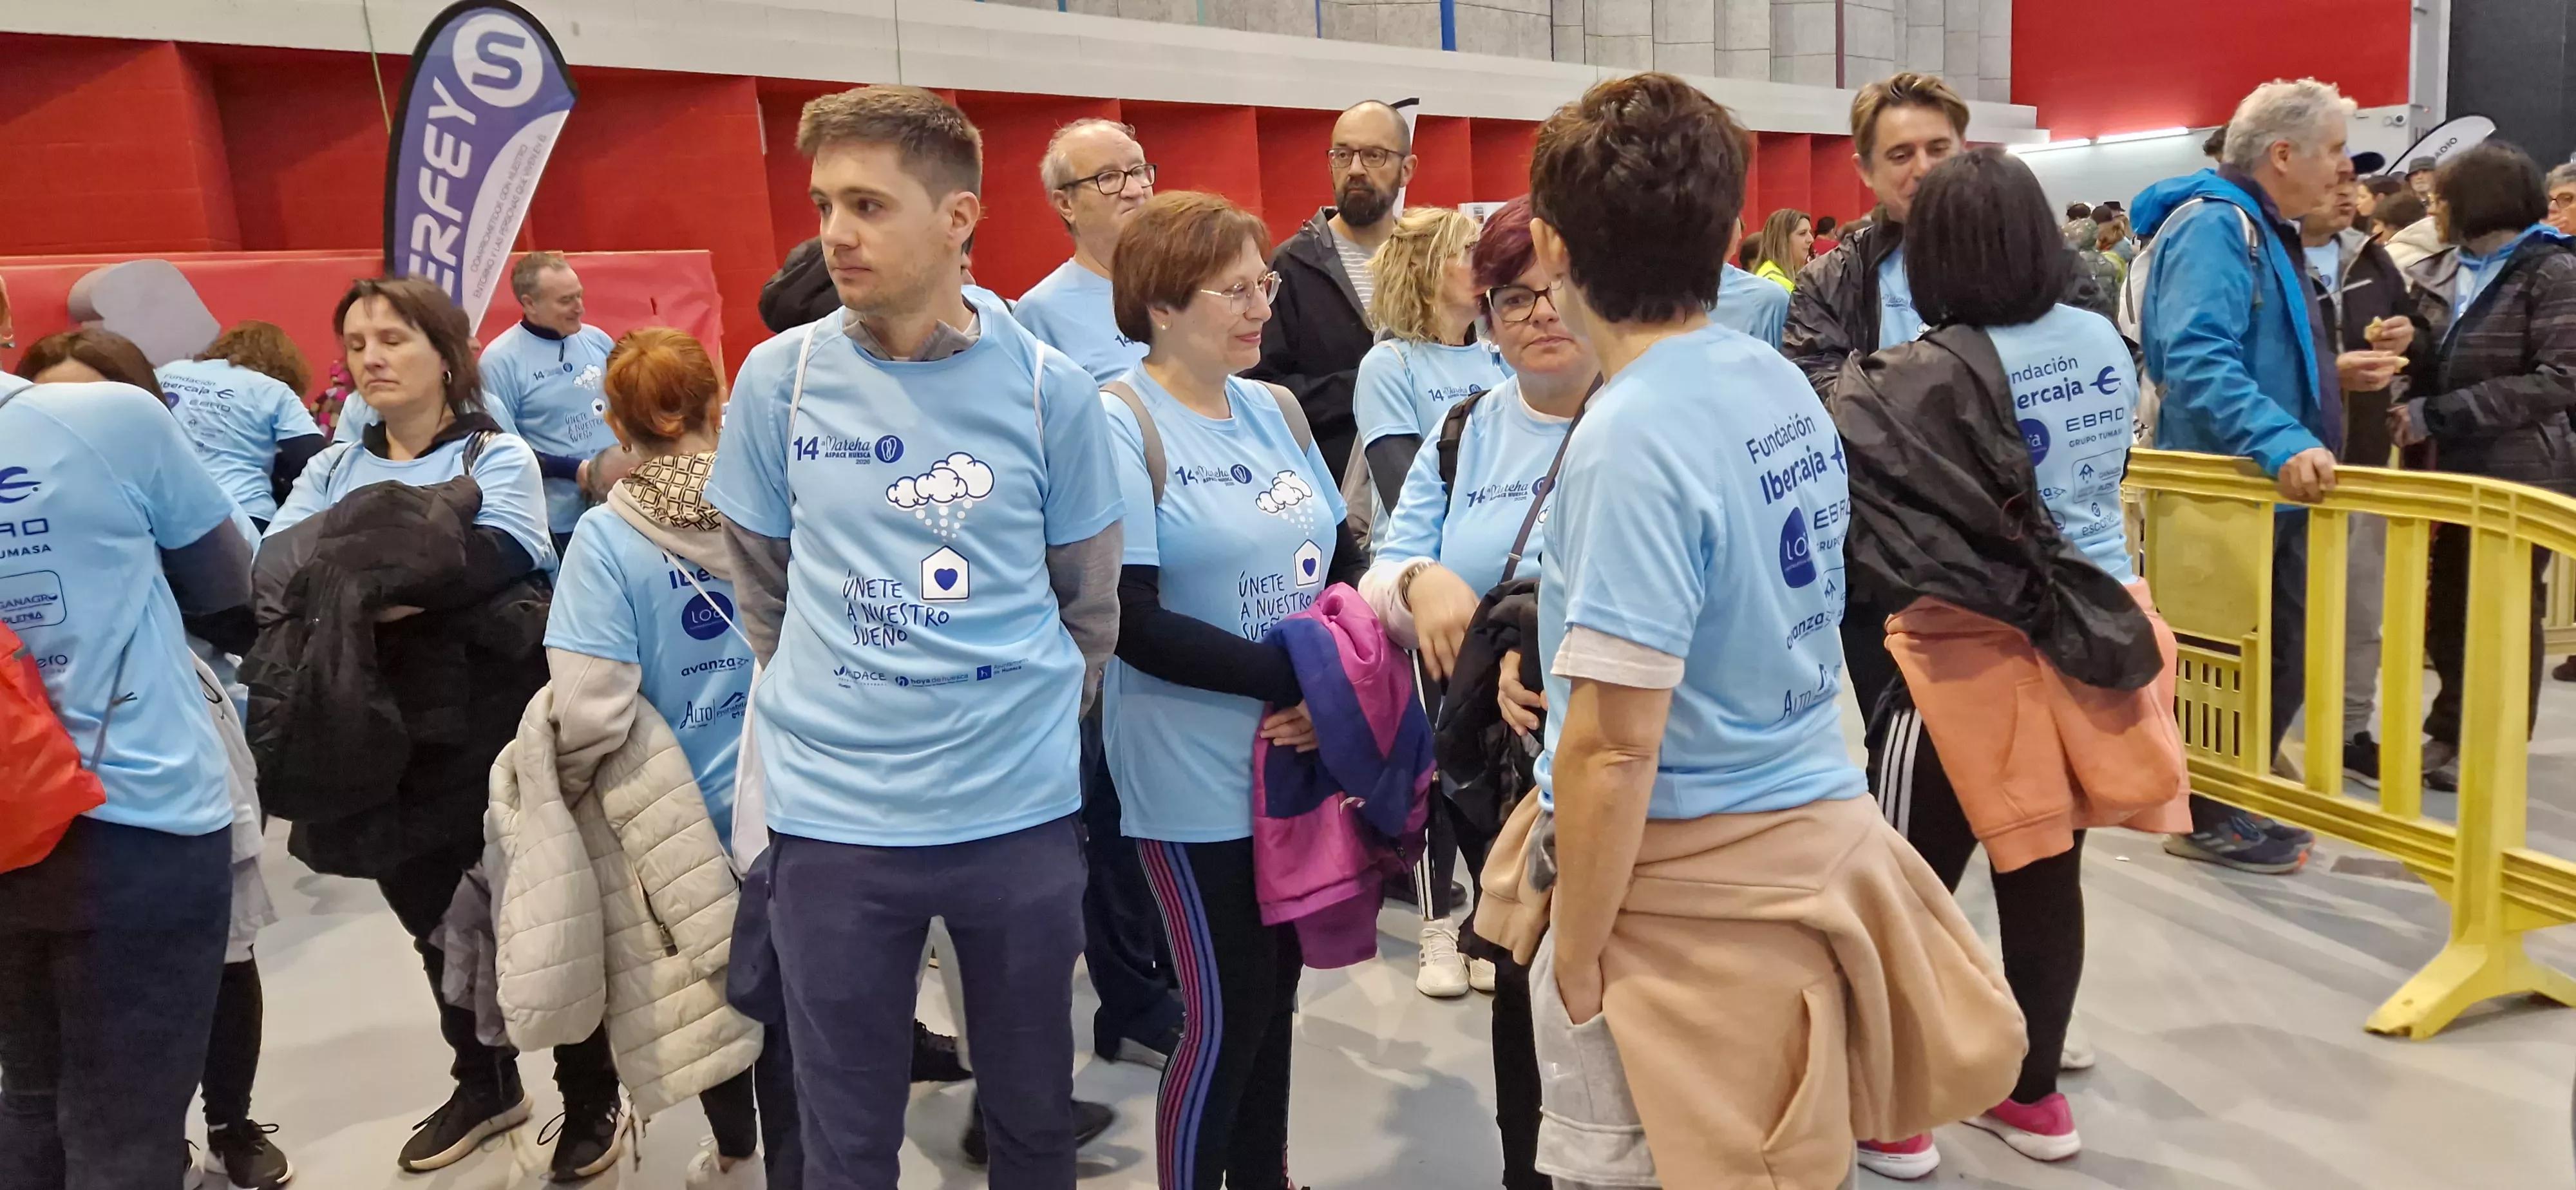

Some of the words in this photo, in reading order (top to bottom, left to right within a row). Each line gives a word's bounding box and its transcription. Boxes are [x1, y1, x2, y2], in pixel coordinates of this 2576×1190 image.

[826, 435, 872, 451] Marcha
[1745, 413, 1817, 465] Fundación
[843, 568, 902, 601] ÚNETE
[1238, 570, 1285, 598] ÚNETE
[847, 601, 857, 622] A
[860, 602, 950, 627] NUESTRO
[1240, 601, 1250, 621] A
[1256, 592, 1312, 619] NUESTRO
[852, 623, 908, 649] SUEÑO
[681, 657, 735, 676] avanza
